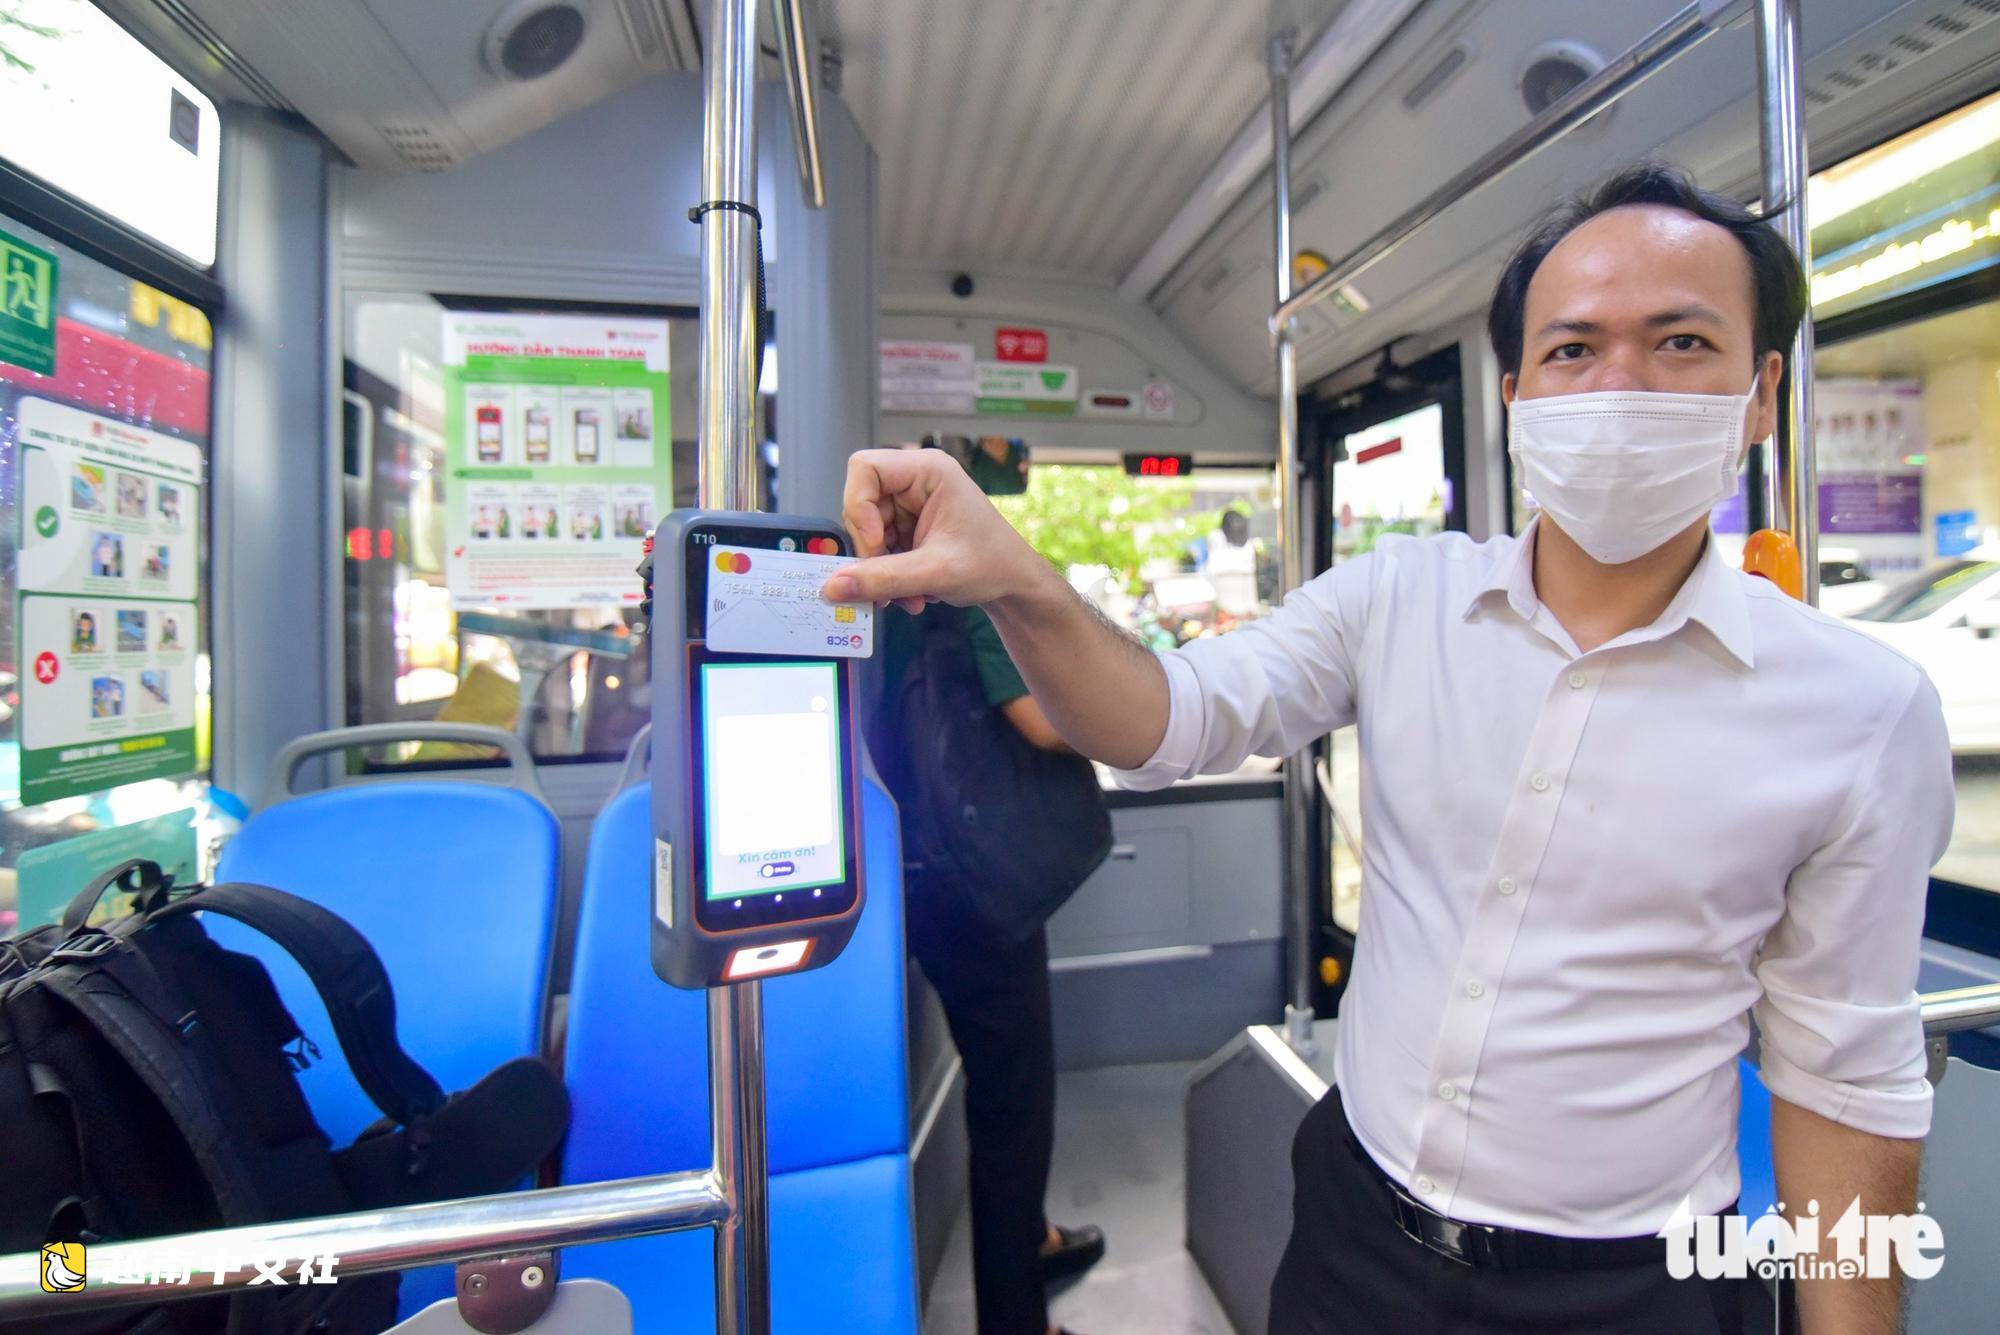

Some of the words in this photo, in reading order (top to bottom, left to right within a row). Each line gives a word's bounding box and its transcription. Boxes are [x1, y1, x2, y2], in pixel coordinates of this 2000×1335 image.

[693, 533, 717, 545] T10
[826, 635, 849, 646] SCB
[739, 852, 759, 863] Xin
